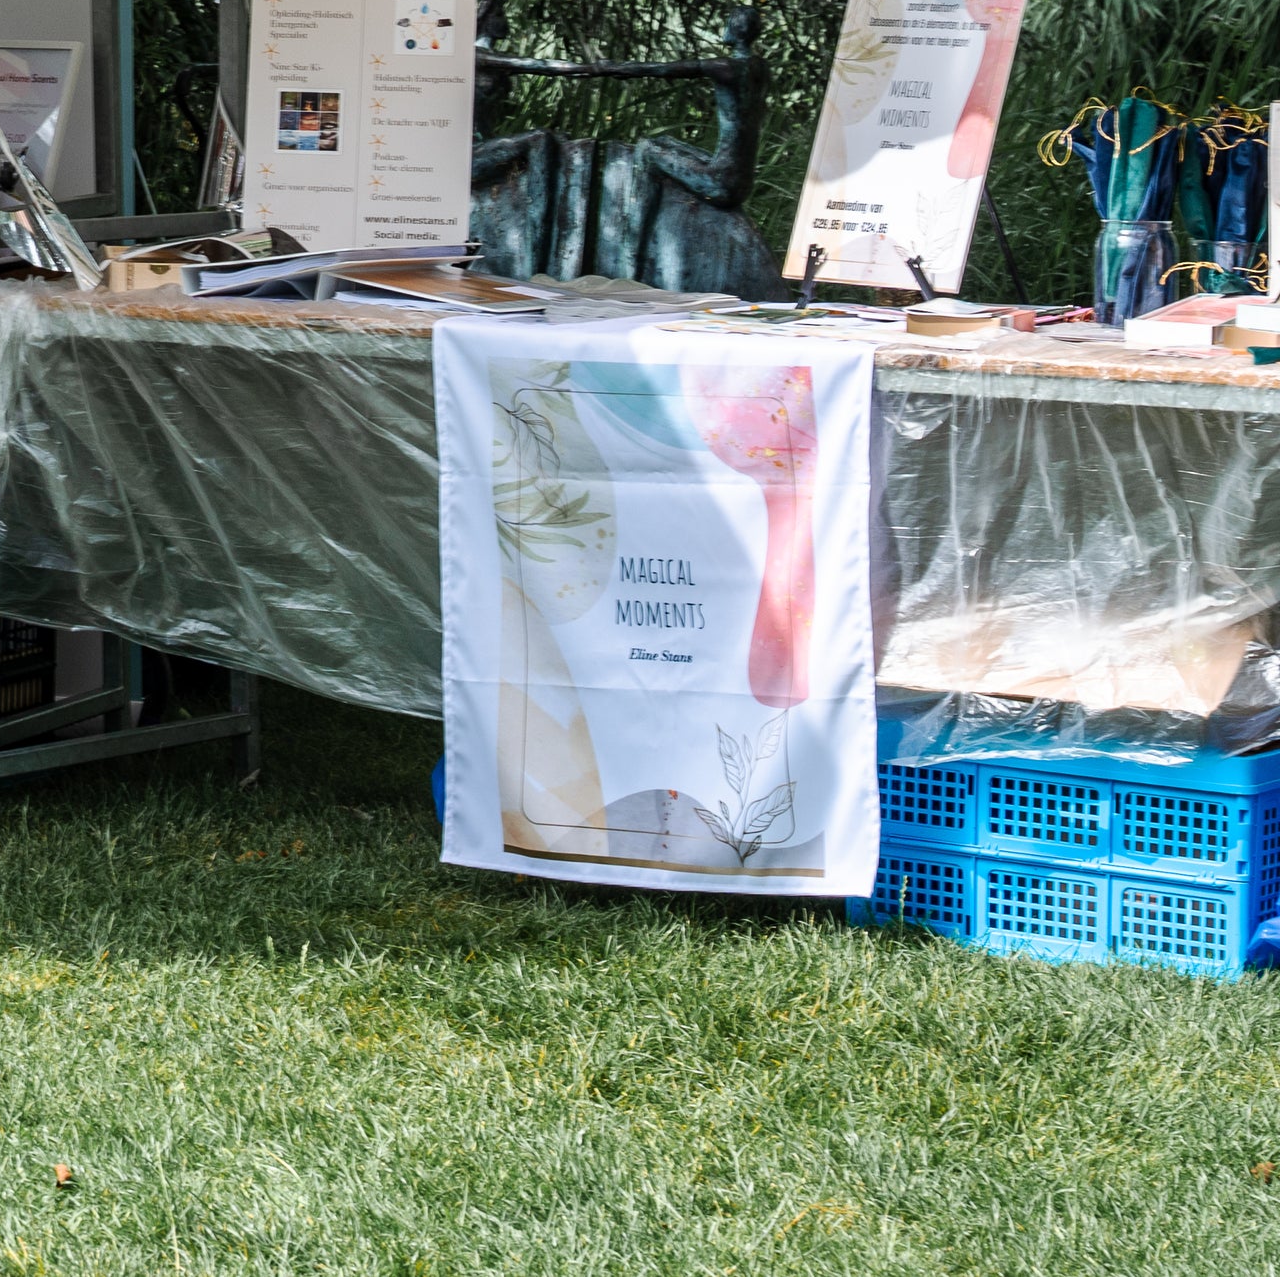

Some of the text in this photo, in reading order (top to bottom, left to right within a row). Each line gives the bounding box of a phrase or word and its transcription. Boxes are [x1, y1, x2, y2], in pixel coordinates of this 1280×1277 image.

[890, 80, 933, 99] MAGICAL
[879, 109, 931, 128] MOMENTS
[363, 216, 458, 226] www.elinestans.nl
[374, 231, 441, 241] Social media:
[620, 556, 696, 586] MAGICAL
[616, 599, 706, 630] MOMENTS
[629, 647, 693, 663] Eline Stans
